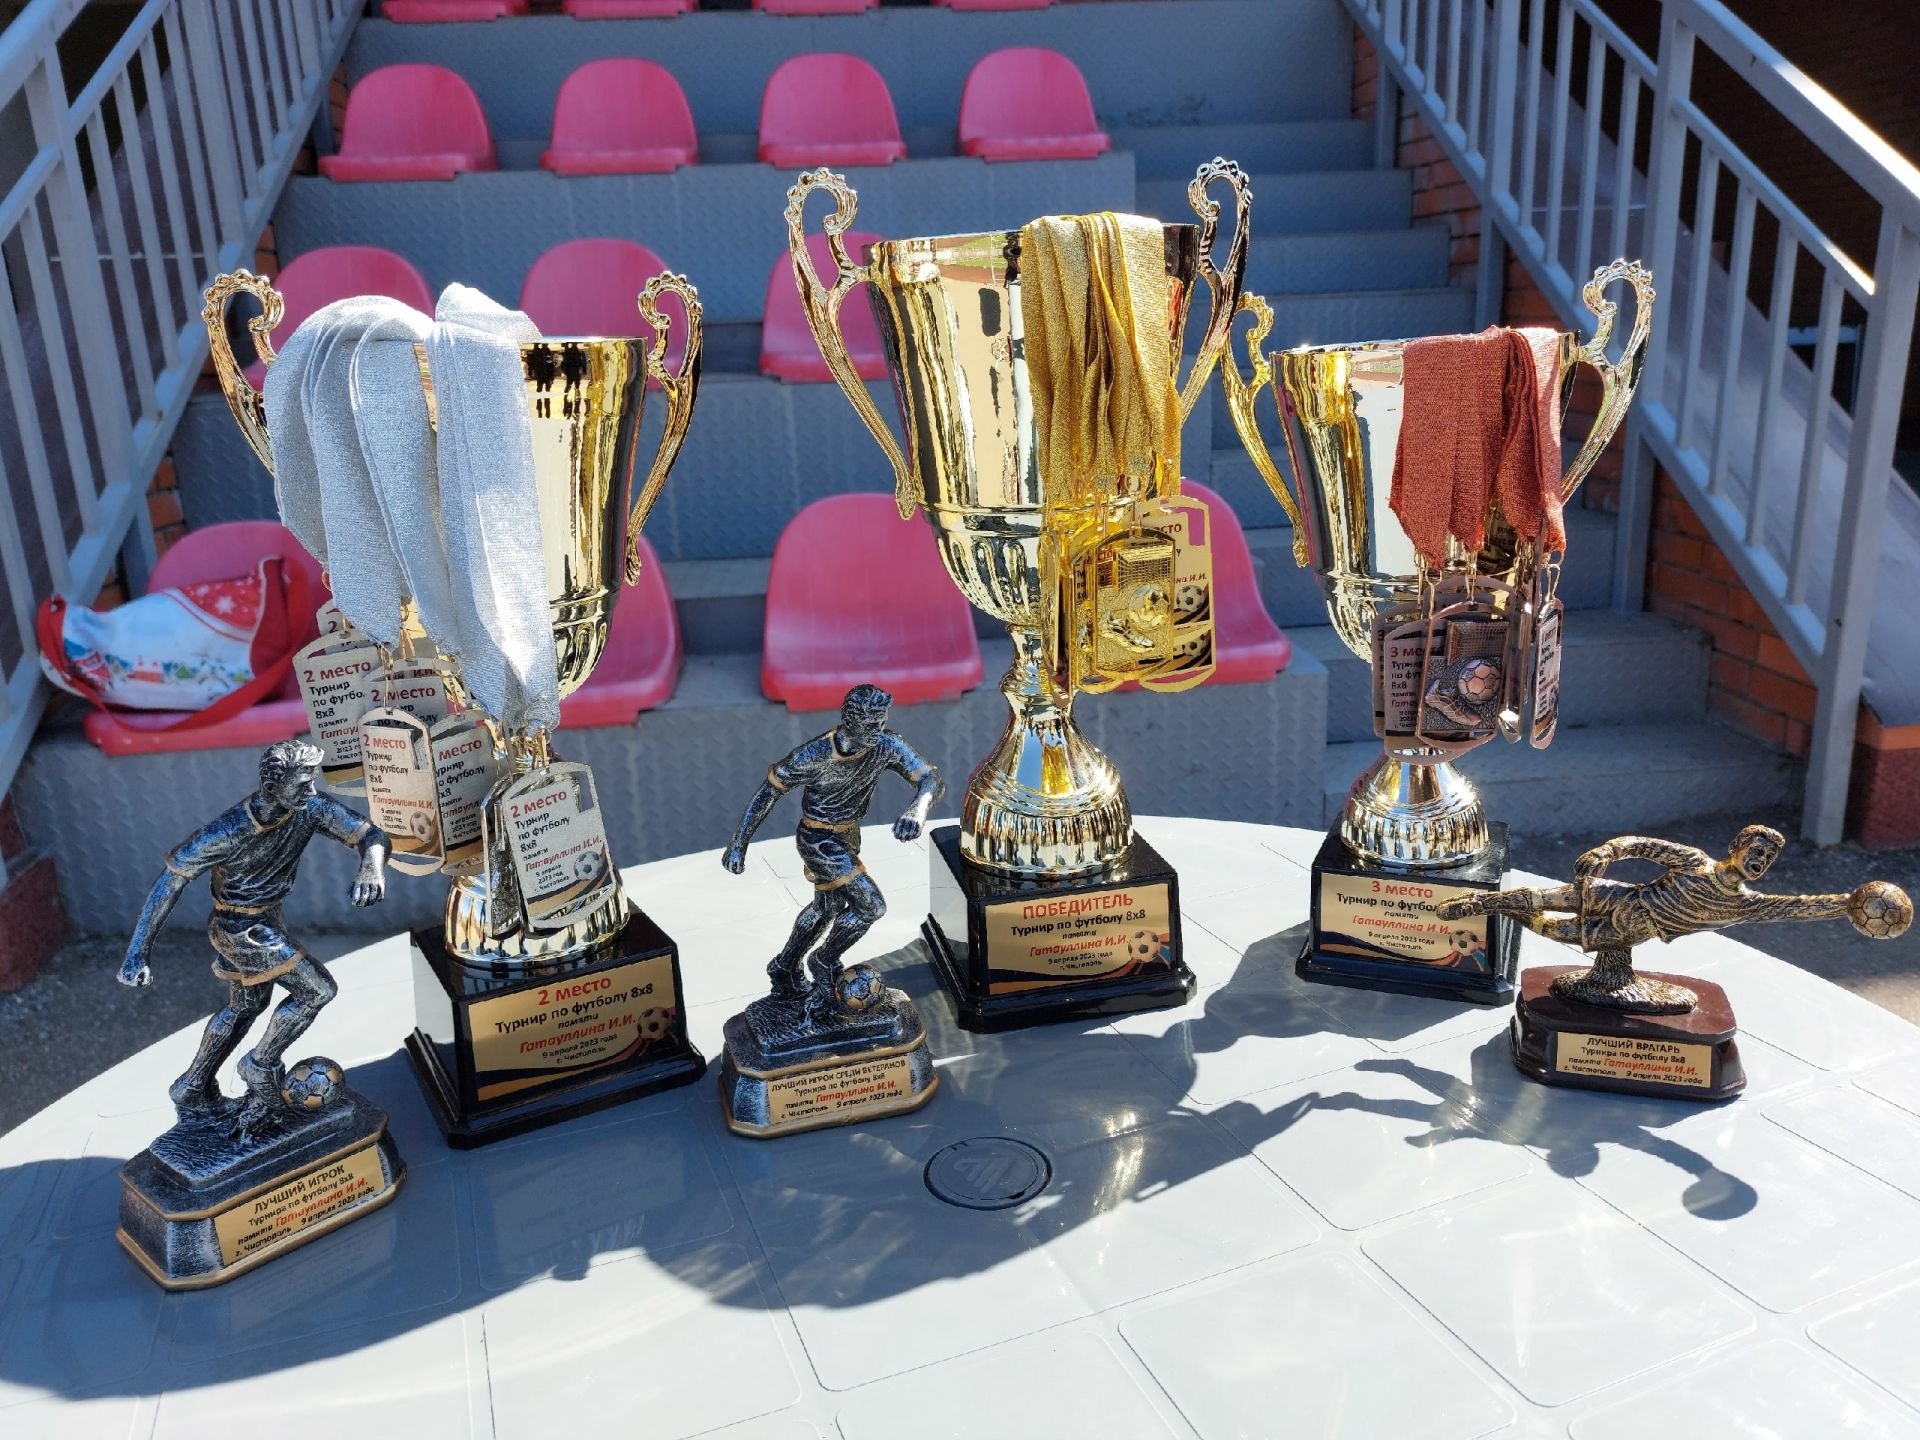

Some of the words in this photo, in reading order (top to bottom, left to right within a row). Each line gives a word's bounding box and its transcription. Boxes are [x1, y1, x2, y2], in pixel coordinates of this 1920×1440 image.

[328, 621, 337, 633] 2
[1391, 647, 1398, 657] 3
[303, 670, 315, 683] 2
[320, 661, 371, 680] место
[309, 681, 350, 695] Турнир
[371, 689, 381, 702] 2
[387, 688, 436, 700] место
[313, 696, 327, 707] по
[329, 690, 365, 705] футбо
[363, 734, 370, 747] 2
[373, 738, 406, 749] место
[366, 751, 393, 762] Турнир
[439, 740, 482, 761] место
[379, 764, 409, 776] футболу
[436, 760, 464, 777] урнир
[446, 765, 485, 785] футболу
[439, 788, 452, 799] х8
[419, 800, 434, 809] И.И.
[511, 805, 520, 818] 2
[524, 791, 567, 814] место
[515, 812, 549, 829] Турнир
[518, 832, 530, 841] по
[532, 816, 570, 837] футболу
[520, 840, 537, 852] 8х8
[583, 836, 602, 849] И.И.
[1371, 880, 1381, 893] 3
[1385, 883, 1433, 898] место
[1023, 893, 1133, 920] ПОБЕДИТЕЛЬ
[1337, 892, 1377, 908] Турнир
[1380, 899, 1394, 908] по
[1397, 899, 1438, 913] футбол
[1011, 924, 1054, 938] Турнир
[1056, 919, 1071, 930] по
[1074, 914, 1123, 929] футболу
[1126, 909, 1146, 921] 8х8
[1352, 915, 1424, 931] Гатауллина
[1384, 911, 1419, 920] памяти
[1062, 930, 1097, 939] памяти
[1030, 939, 1102, 957] Гатауллина
[1105, 934, 1129, 946] И.И.
[538, 989, 550, 1006] 2
[555, 977, 612, 1001] место
[495, 1012, 547, 1034] Турнир
[552, 1007, 569, 1019] по
[571, 992, 627, 1015] футболу
[631, 983, 654, 999] 8х8
[558, 1013, 599, 1029] памяти
[520, 1023, 605, 1053] Гатауллина
[608, 1013, 636, 1029] И.И.
[1586, 1037, 1633, 1050] ЛУЧШИЙ
[1636, 1042, 1680, 1054] ВРАТАРЬ
[1581, 1046, 1617, 1058] Турнира
[1632, 1051, 1669, 1064] футболу
[771, 1077, 807, 1092] ЛУЧШИЙ
[808, 1073, 834, 1085] ИГРОК
[835, 1068, 861, 1080] СРЕДИ
[862, 1059, 906, 1074] ВЕТЕРАНОВ
[1603, 1059, 1671, 1073] Гатауллина
[1674, 1066, 1698, 1076] И.И.
[1663, 1074, 1682, 1083] 2023
[794, 1085, 827, 1097] Турнира
[816, 1085, 874, 1103] Гатауллина
[876, 1080, 897, 1090] И.И.
[255, 1180, 306, 1214] ЛУЧШИЙ
[308, 1165, 345, 1188] ИГРОК
[238, 1224, 273, 1245] памяти
[275, 1190, 344, 1227] Гатауллина
[346, 1177, 368, 1194] И.И.
[248, 1205, 287, 1227] Турнира
[288, 1199, 300, 1209] по
[302, 1181, 338, 1204] футболу
[244, 1227, 292, 1251] Чистополь
[301, 1217, 307, 1225] 9
[337, 1195, 356, 1208] 2023
